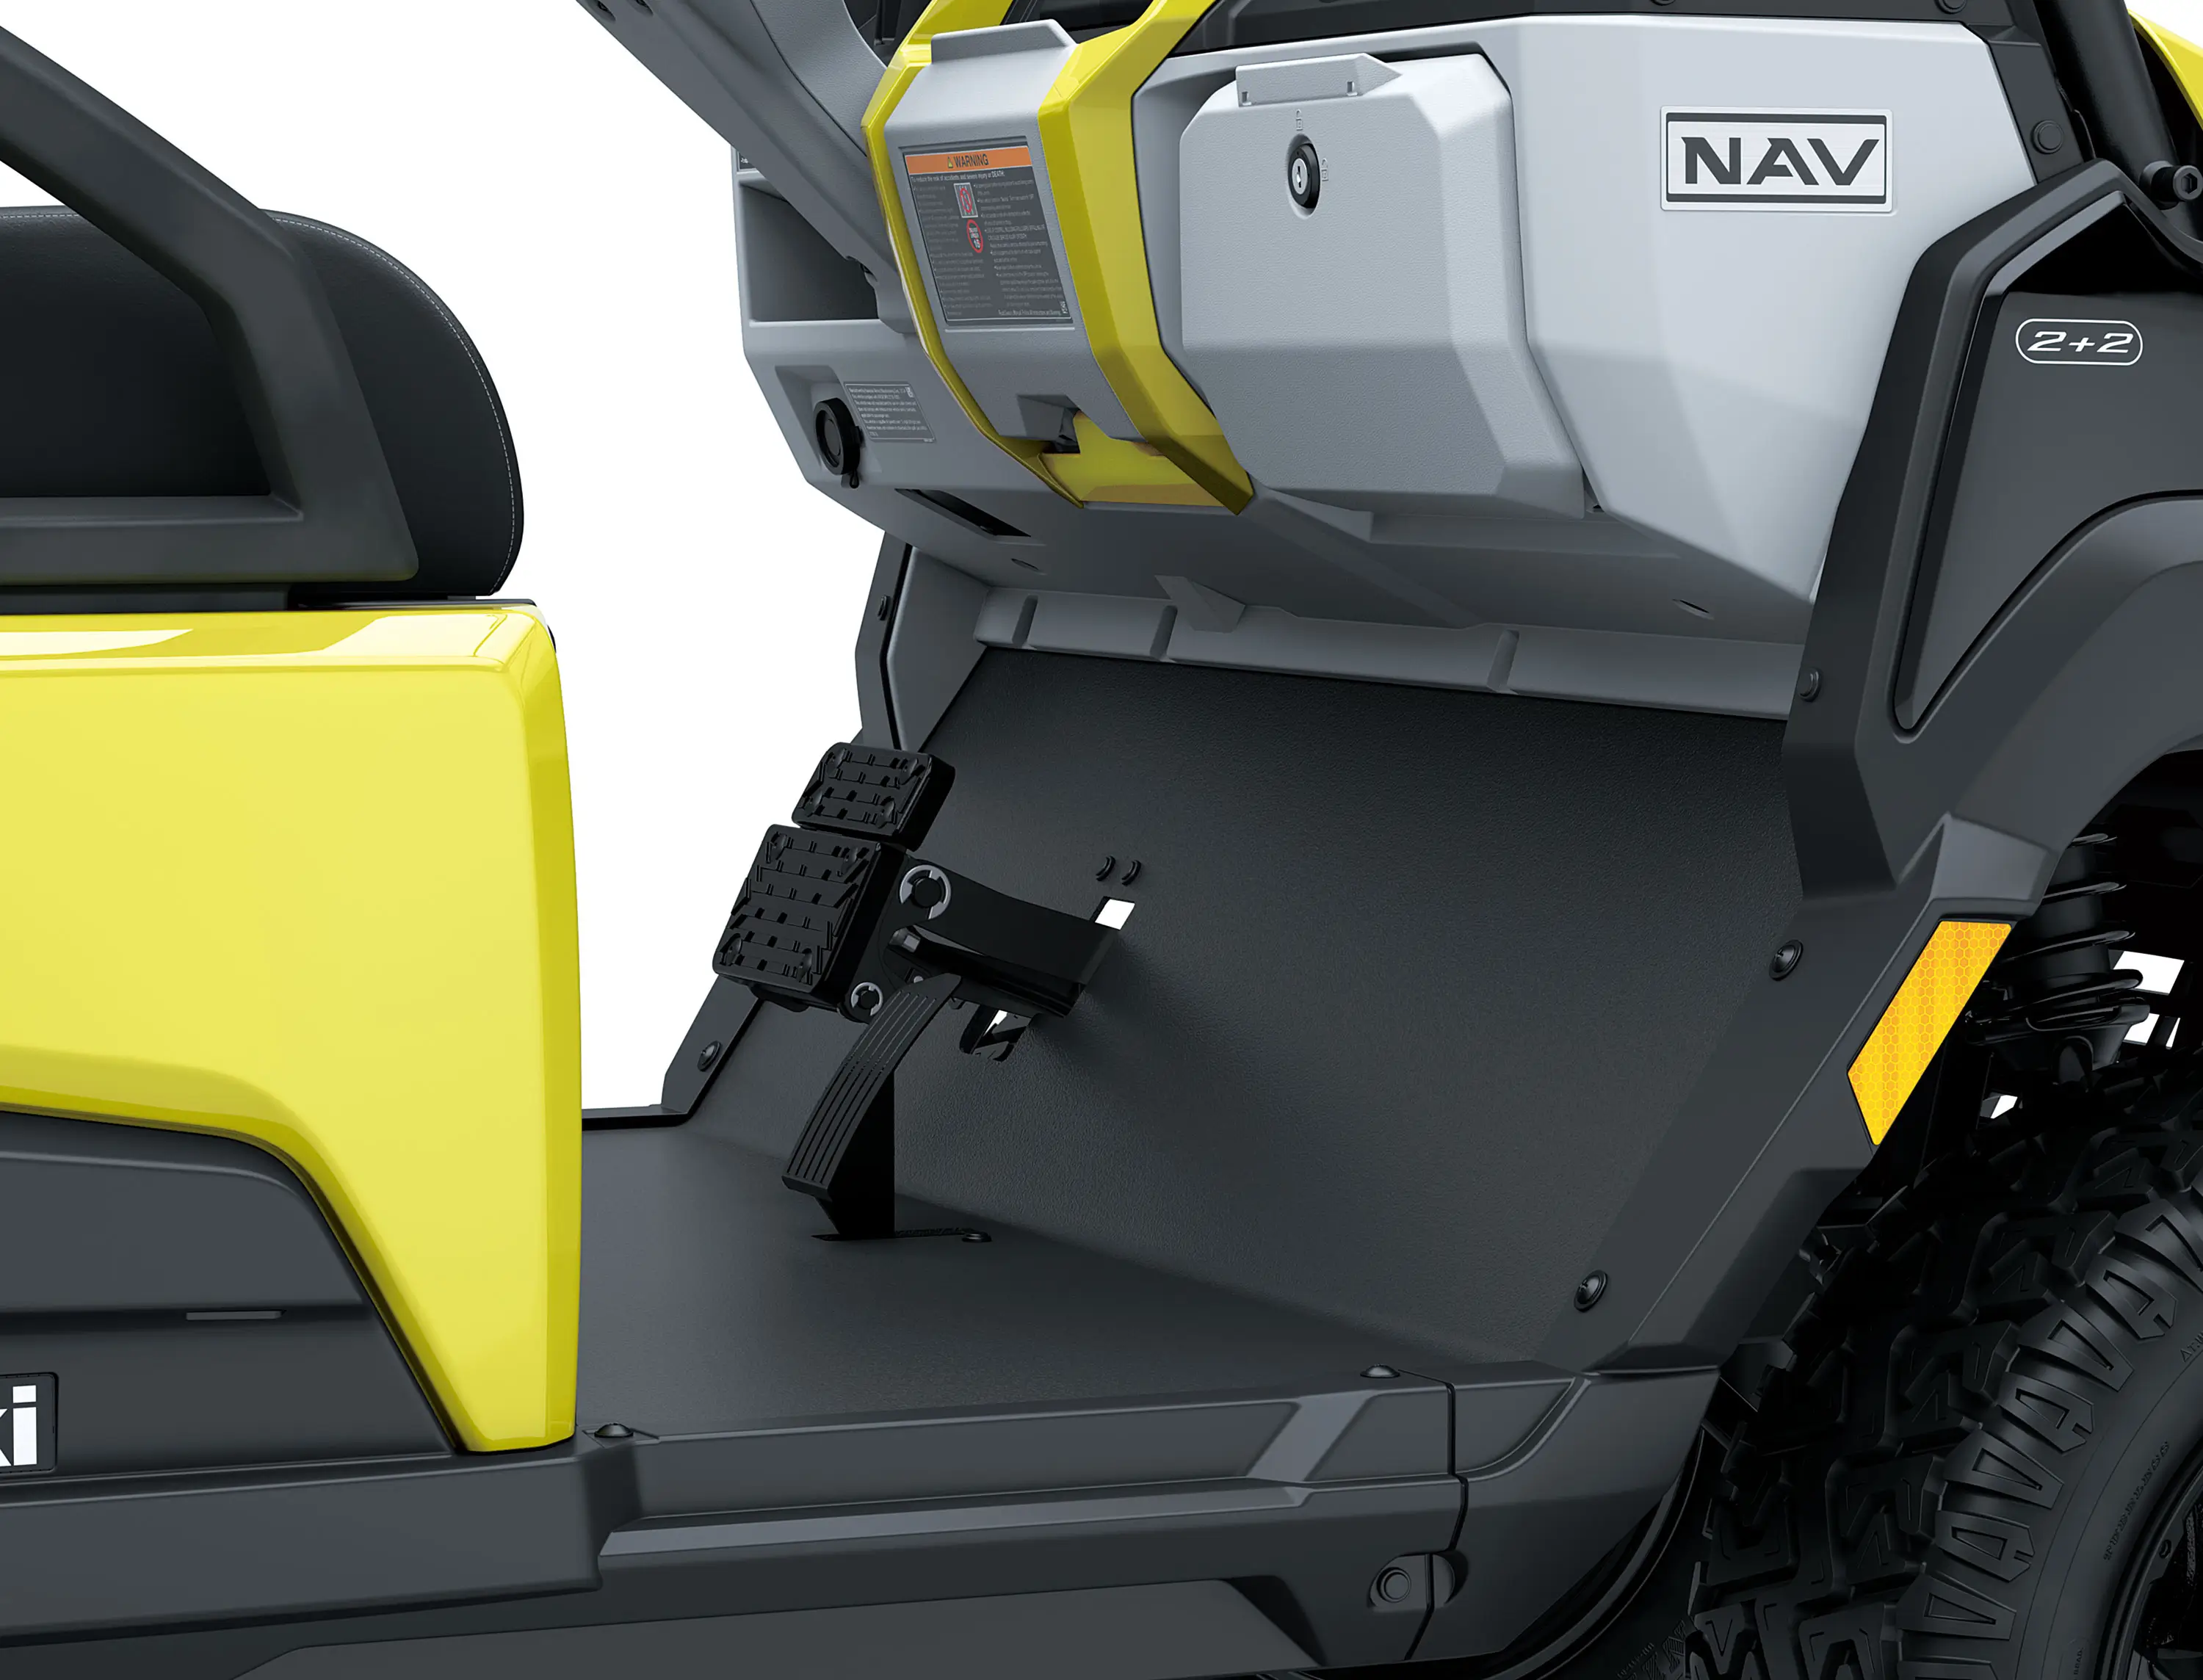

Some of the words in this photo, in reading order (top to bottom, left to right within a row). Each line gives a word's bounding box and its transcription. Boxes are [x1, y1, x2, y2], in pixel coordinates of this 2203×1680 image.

[953, 153, 989, 167] WARNING
[1681, 137, 1880, 186] NAV
[2027, 331, 2134, 353] 2+2
